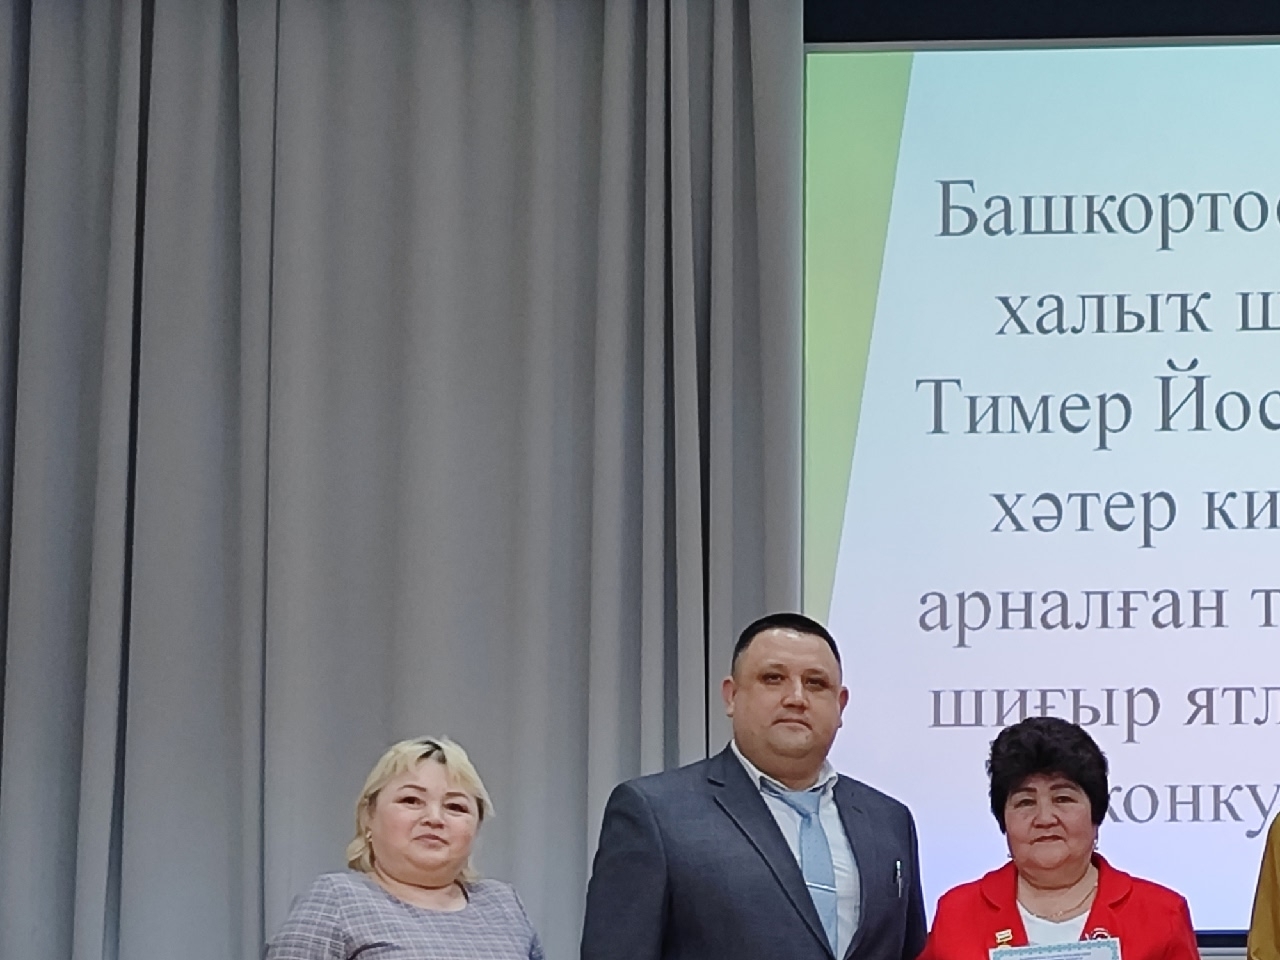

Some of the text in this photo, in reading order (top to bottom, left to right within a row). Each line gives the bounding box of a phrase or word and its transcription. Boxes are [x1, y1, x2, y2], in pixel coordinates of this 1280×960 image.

[994, 290, 1213, 337] халыҡ
[914, 377, 1133, 451] Тимер
[989, 488, 1178, 549] хәтер
[917, 584, 1230, 649] арналған
[928, 686, 1162, 744] шиғыр
